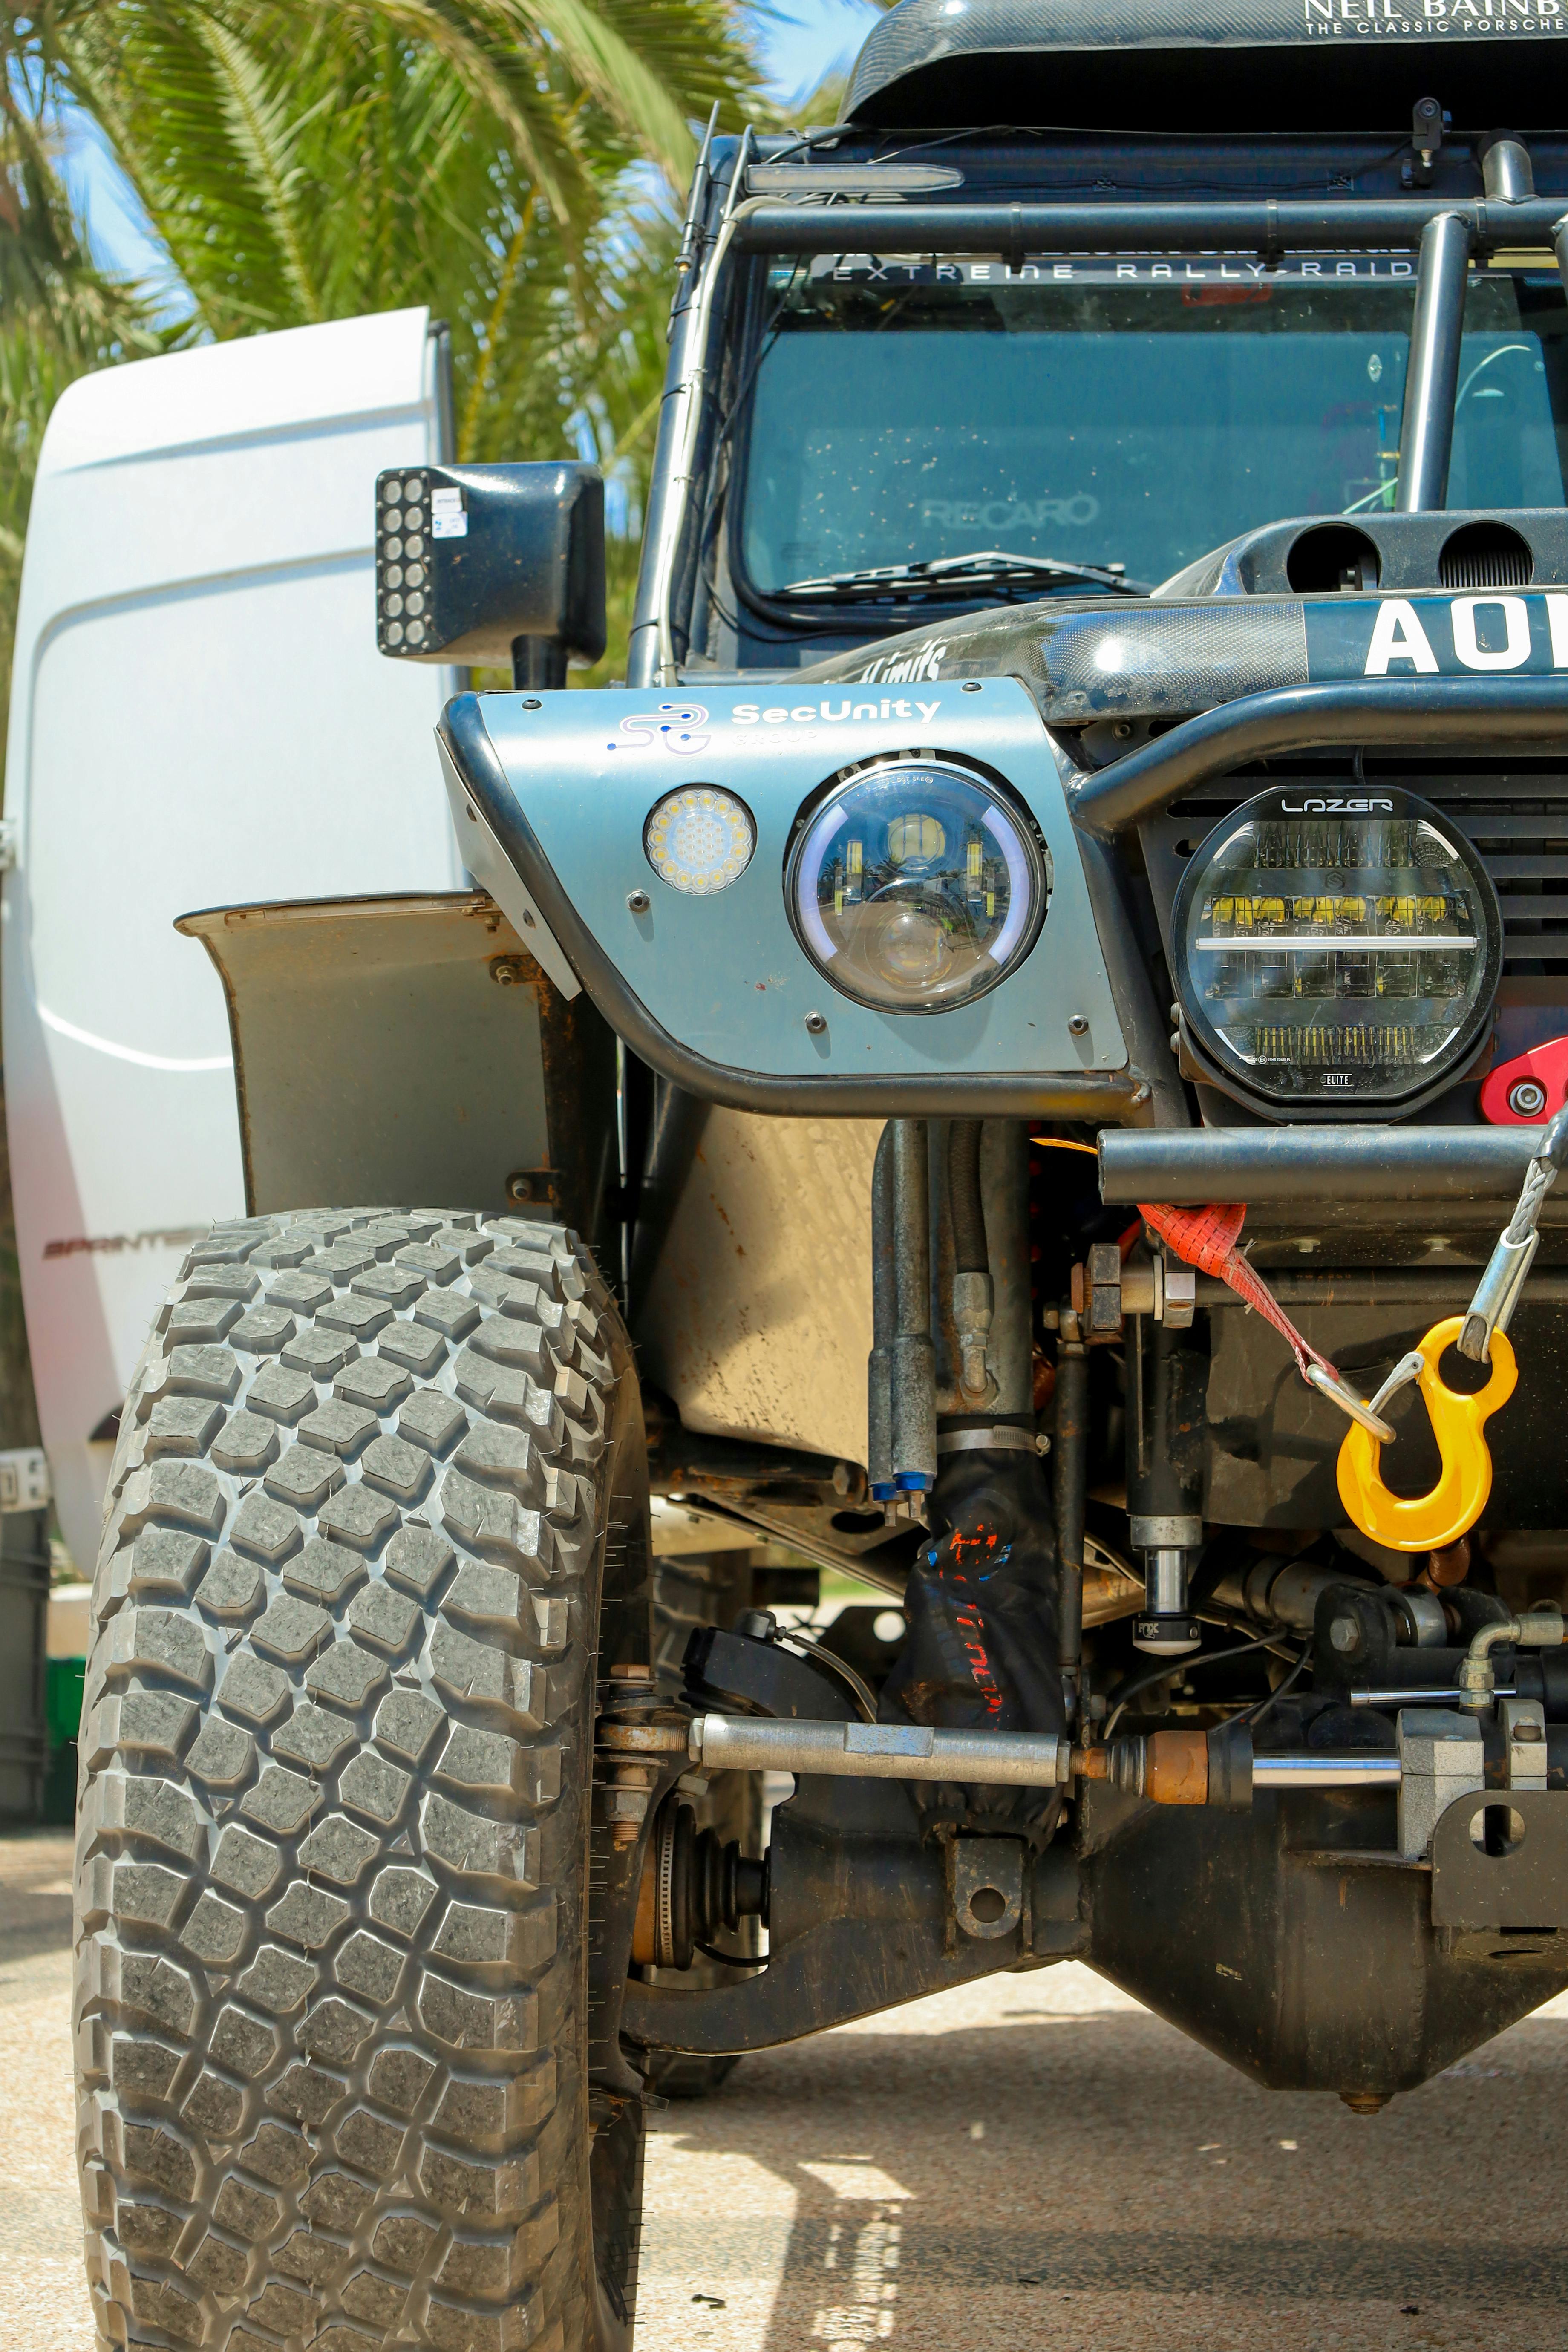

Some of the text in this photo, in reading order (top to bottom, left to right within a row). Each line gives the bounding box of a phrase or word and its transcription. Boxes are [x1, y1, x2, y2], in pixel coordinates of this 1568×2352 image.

[1304, 0, 1568, 19] NEIL BAINB
[1306, 18, 1564, 35] THE CLASSIC PORSCHE
[833, 264, 1073, 280] EXTREME
[922, 493, 1101, 531] RECARO
[731, 700, 941, 725] SecUnity
[732, 730, 818, 746] GROUP
[1281, 799, 1393, 812] LAZER
[1327, 1076, 1349, 1084] ELITE
[1138, 1623, 1159, 1639] FOX
